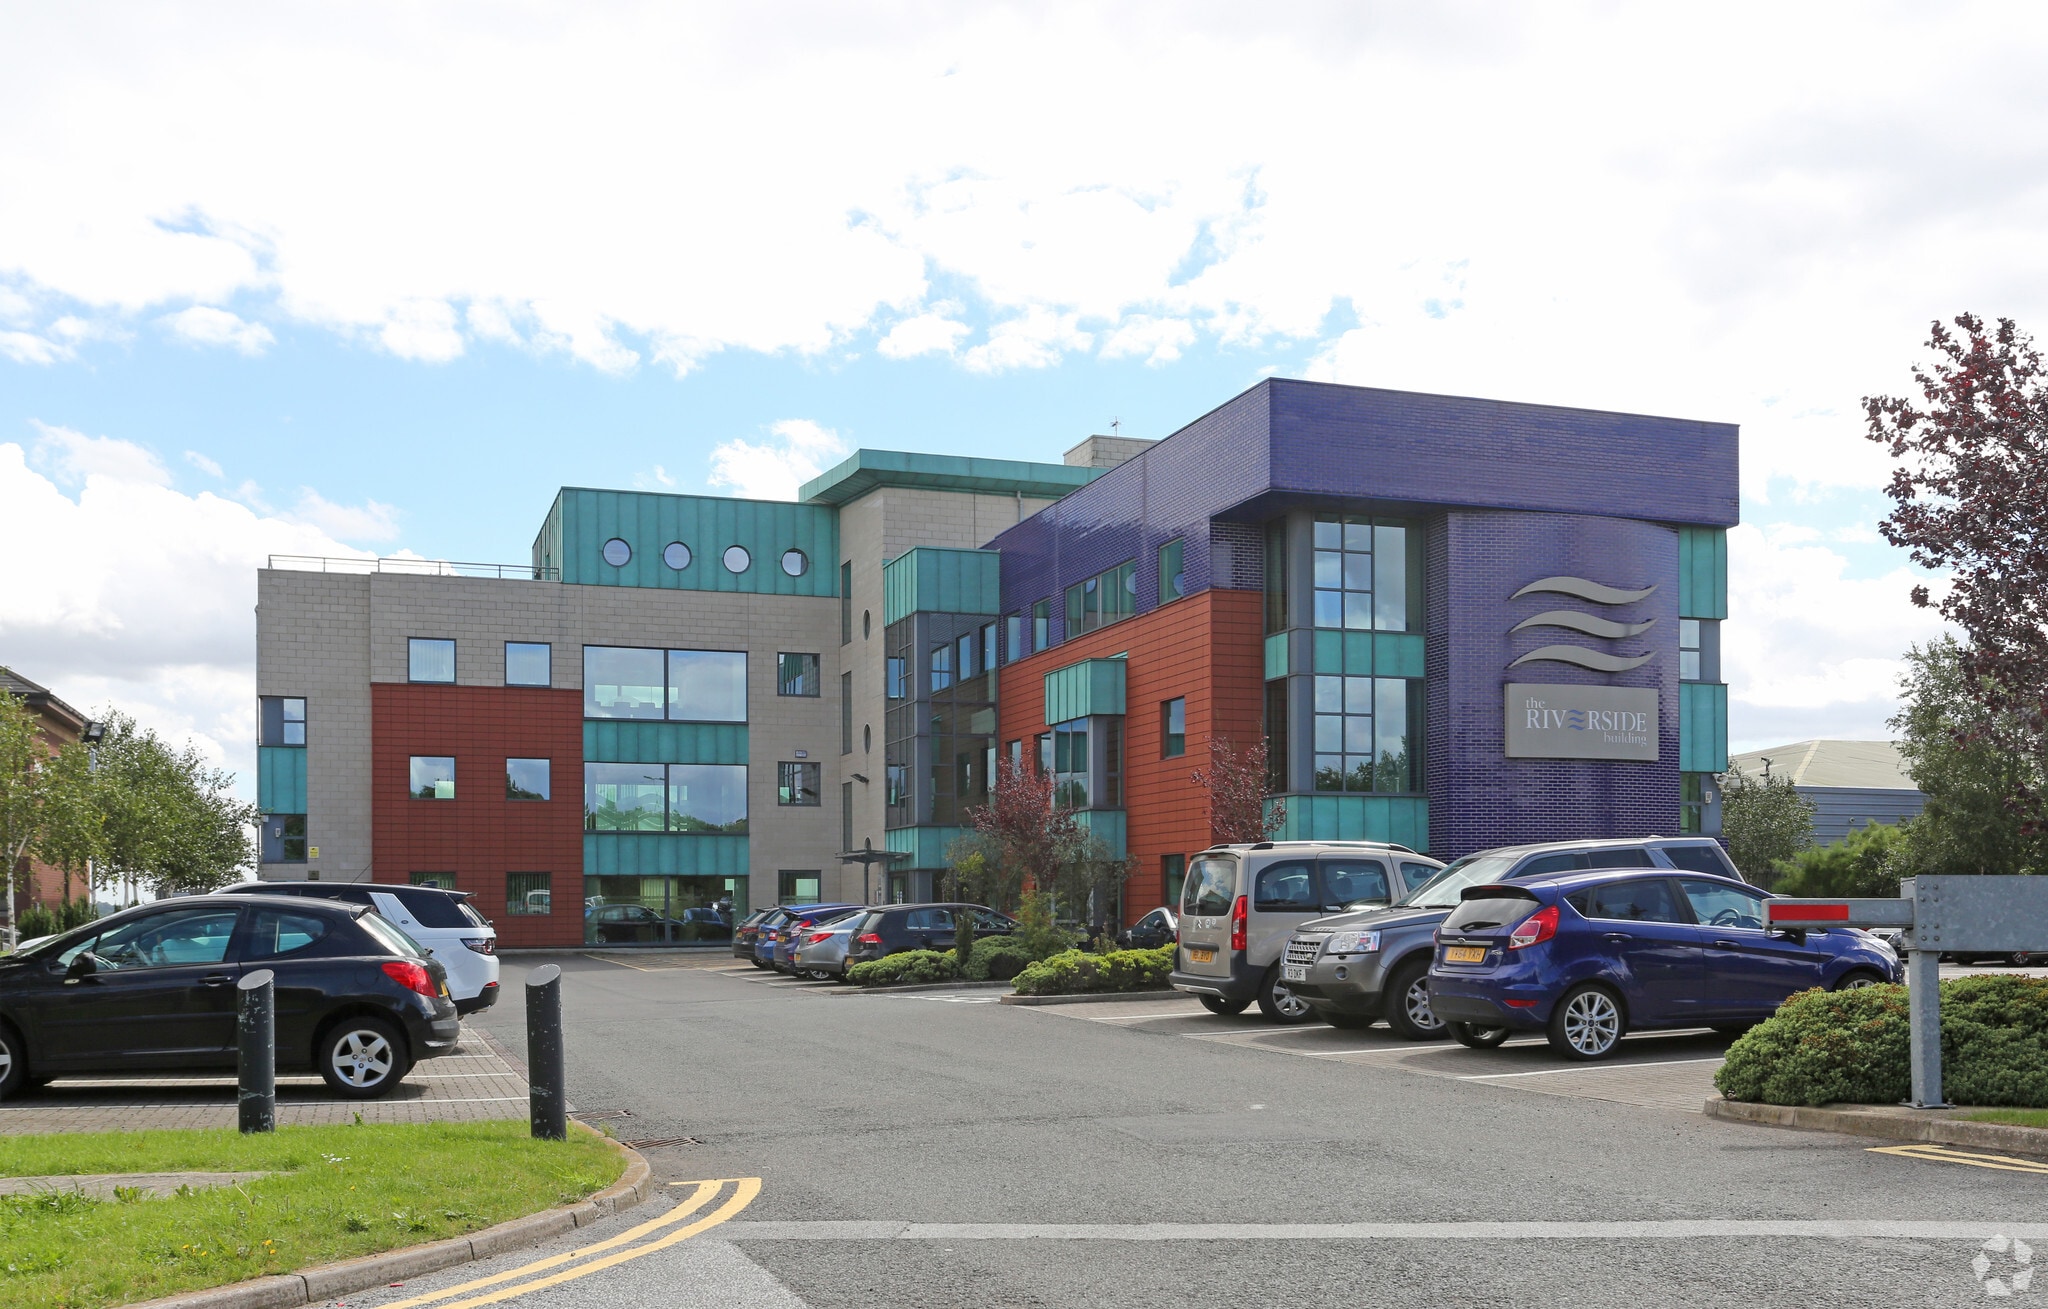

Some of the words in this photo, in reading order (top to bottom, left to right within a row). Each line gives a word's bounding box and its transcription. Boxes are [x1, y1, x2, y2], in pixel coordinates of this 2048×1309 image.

[1526, 697, 1546, 709] the
[1526, 708, 1647, 732] RIVERSIDE
[1603, 732, 1647, 747] building
